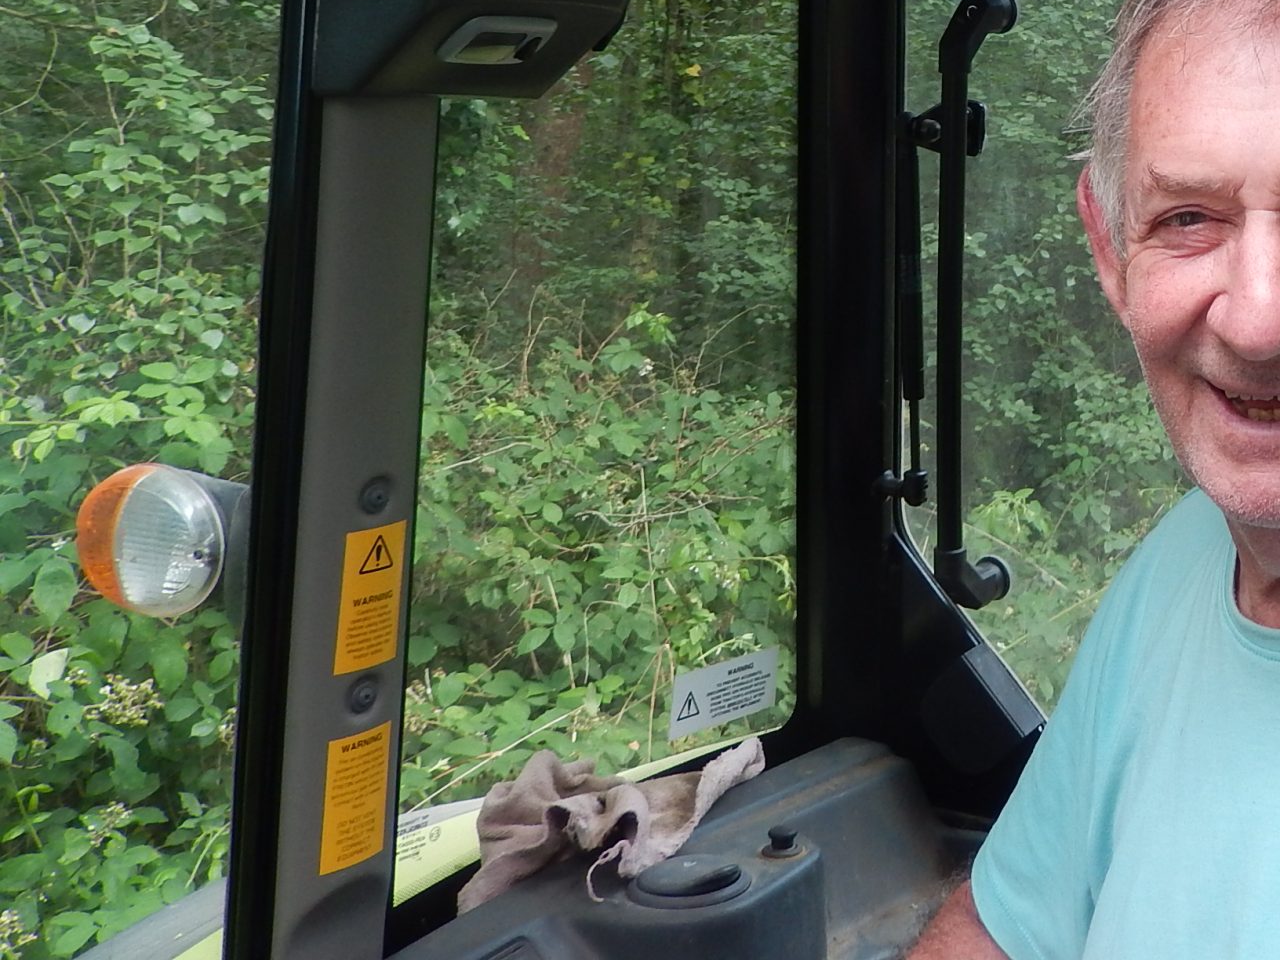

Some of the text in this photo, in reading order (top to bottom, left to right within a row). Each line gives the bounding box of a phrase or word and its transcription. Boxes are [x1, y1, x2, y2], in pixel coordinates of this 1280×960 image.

[352, 589, 393, 607] WARNING
[727, 662, 754, 676] WARNING
[341, 732, 383, 753] WARNING
